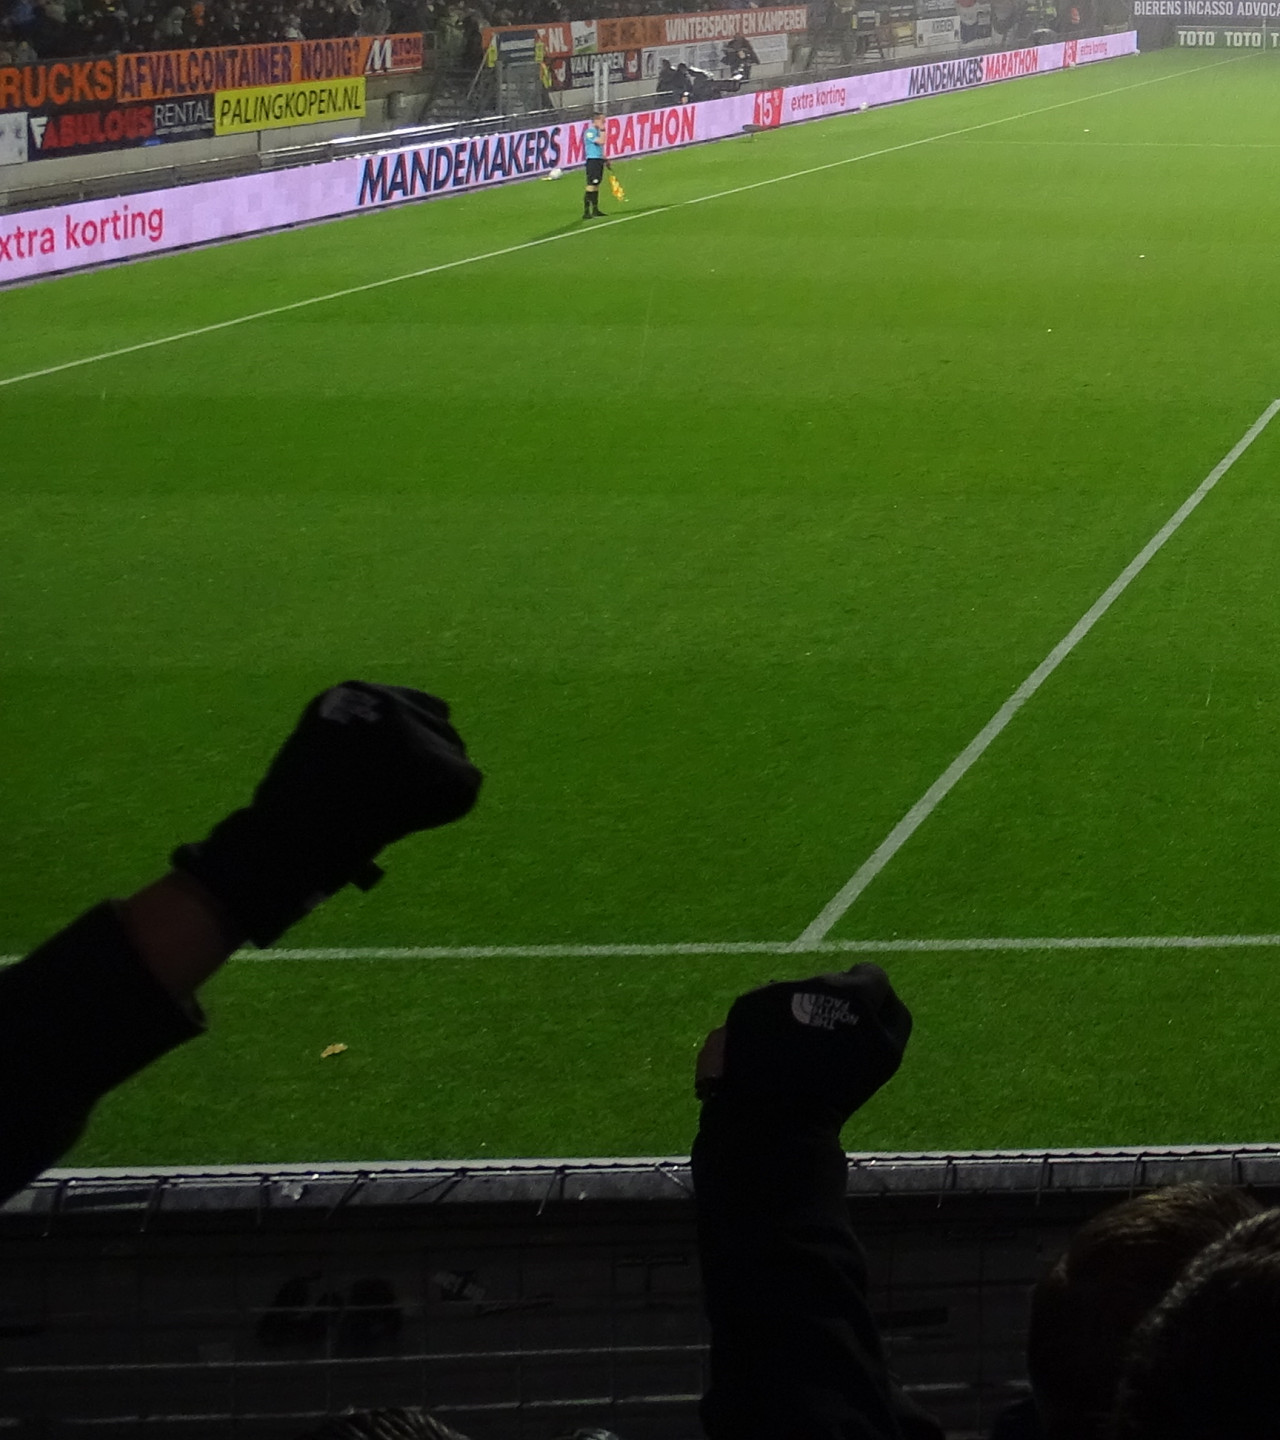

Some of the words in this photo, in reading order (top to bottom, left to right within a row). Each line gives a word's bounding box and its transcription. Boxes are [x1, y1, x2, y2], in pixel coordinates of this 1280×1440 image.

[665, 13, 741, 42] WINTERSPORT
[742, 12, 756, 34] EN
[757, 8, 807, 33] KAMPEREN
[1134, 0, 1181, 16] BIERENS
[1184, 1, 1233, 17] INCASSO
[1178, 30, 1215, 47] TOTO
[1224, 31, 1262, 48] TOTO
[0, 60, 114, 108] RUCKS
[121, 45, 292, 98] AFVALCONTAINER
[908, 57, 984, 96] MANDEMAKERS
[985, 48, 1039, 81] MARATHON
[219, 85, 362, 127] PALINGKOPEN.NL
[791, 92, 814, 111] extra
[816, 84, 846, 109] korting
[30, 106, 155, 149] FABULOUS
[155, 101, 214, 127] RENTAL
[358, 126, 562, 206] MANDEMAKERS
[567, 105, 696, 164] MRATHON
[65, 204, 164, 250] korting
